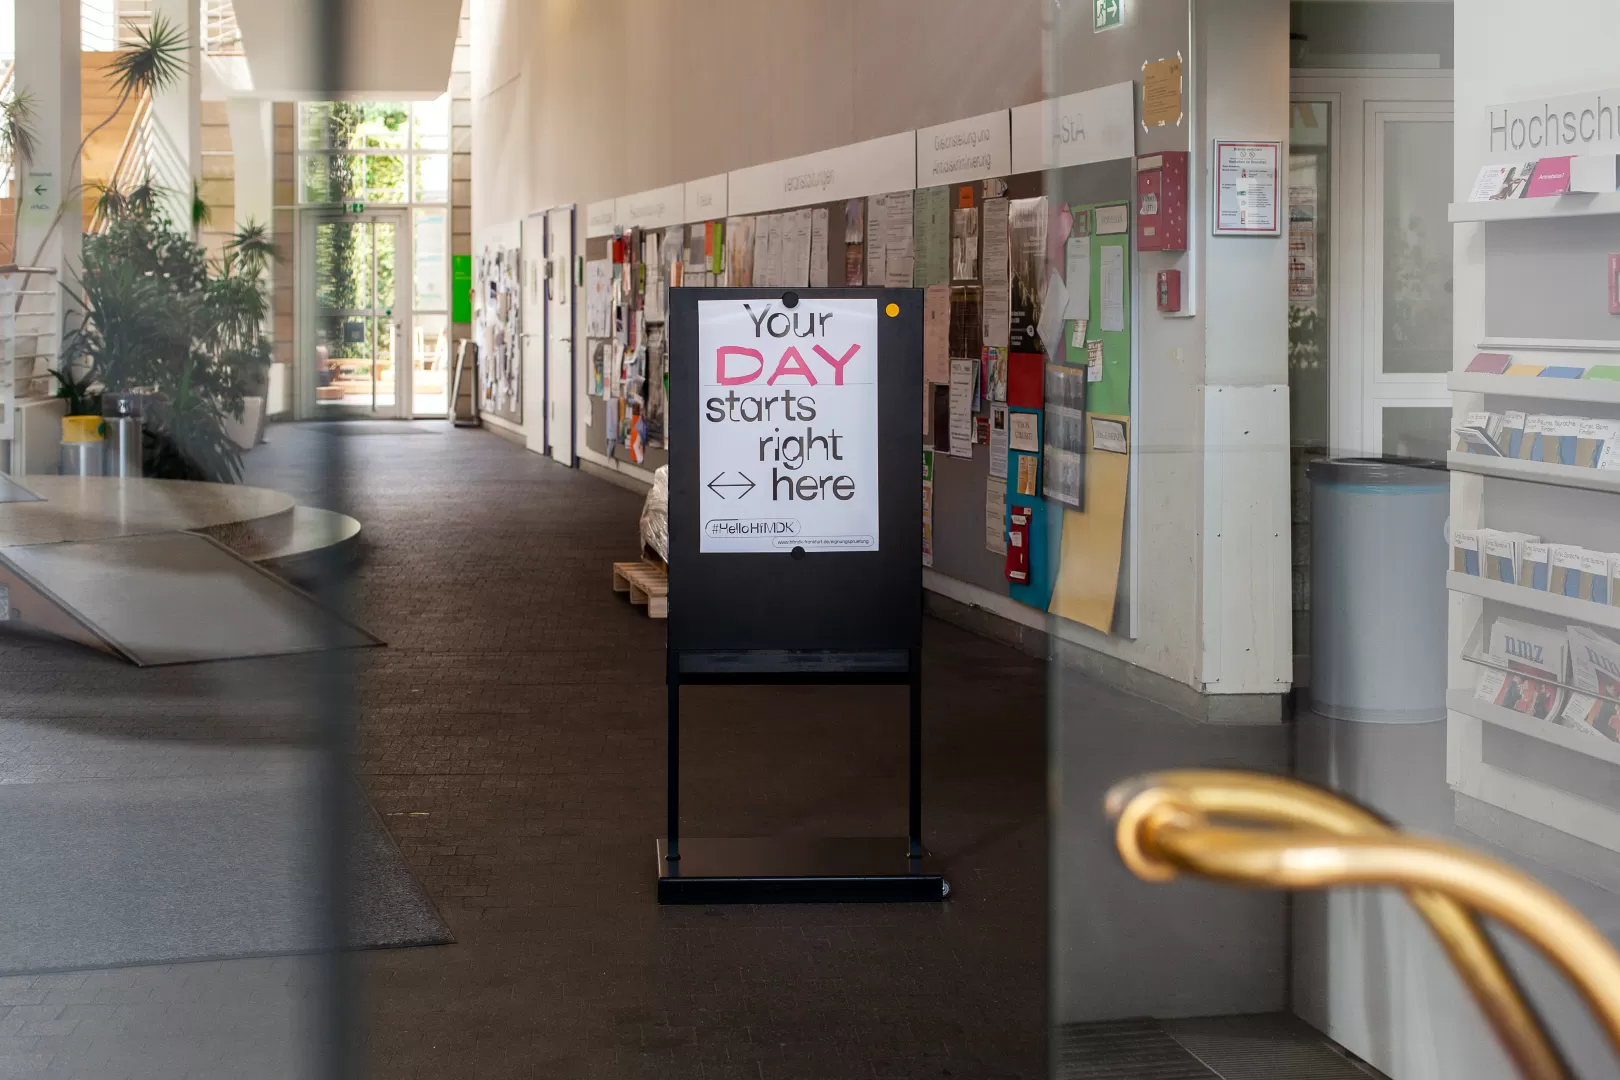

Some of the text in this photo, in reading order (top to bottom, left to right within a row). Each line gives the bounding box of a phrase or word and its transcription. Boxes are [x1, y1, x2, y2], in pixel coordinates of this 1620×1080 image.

[1052, 113, 1086, 146] AStA
[743, 303, 834, 338] Your
[716, 343, 862, 387] DAY
[705, 389, 817, 423] starts
[759, 427, 843, 470] right
[772, 467, 856, 501] here
[711, 521, 794, 534] #HelloHfMDK
[1504, 635, 1544, 665] nmz
